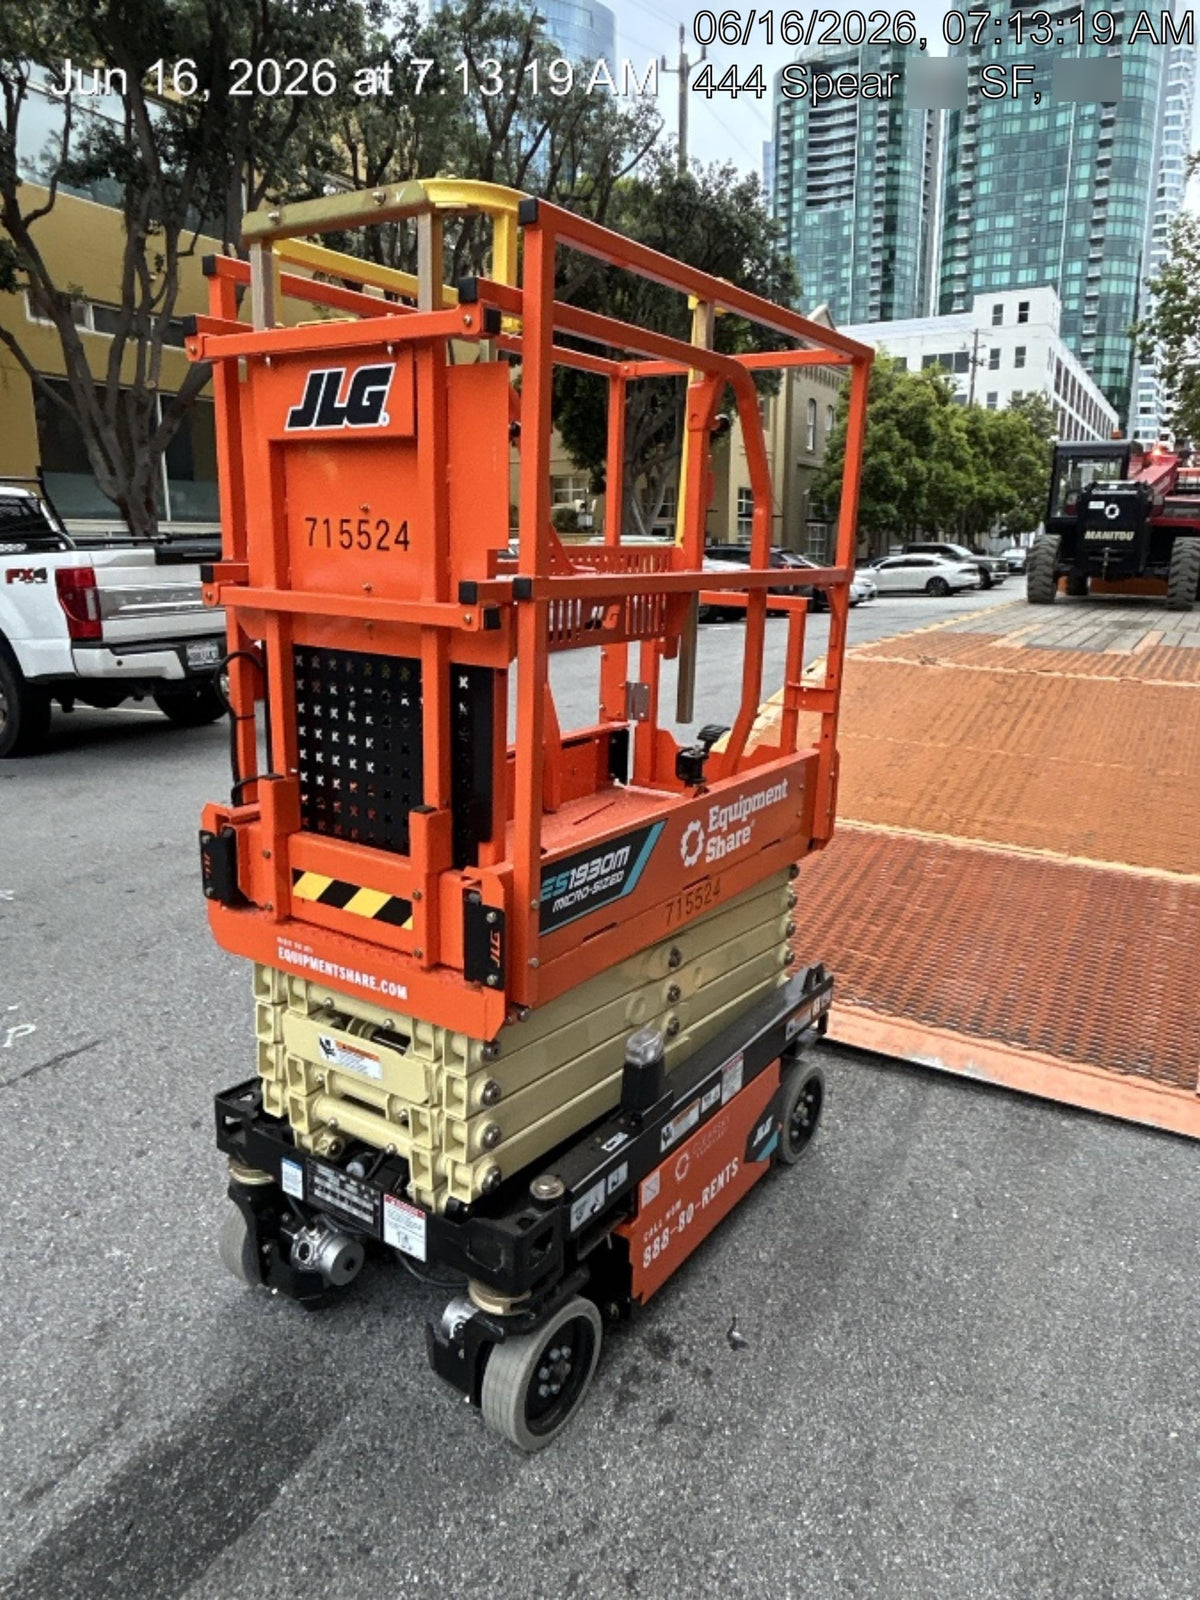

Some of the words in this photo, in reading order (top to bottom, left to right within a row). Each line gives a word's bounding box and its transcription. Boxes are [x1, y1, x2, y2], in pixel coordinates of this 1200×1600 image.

[284, 362, 397, 432] JLG
[304, 516, 411, 552] 715524
[1084, 530, 1135, 541] MANITOU
[5, 567, 49, 584] FX4
[707, 778, 789, 833] Equipment
[705, 825, 751, 863] Share
[552, 870, 625, 913] MICRO-SIZED
[665, 877, 722, 926] 715524
[277, 946, 408, 1000] EQUIPMENTSHARE.COM
[643, 1157, 740, 1269] 888-80-RENTS
